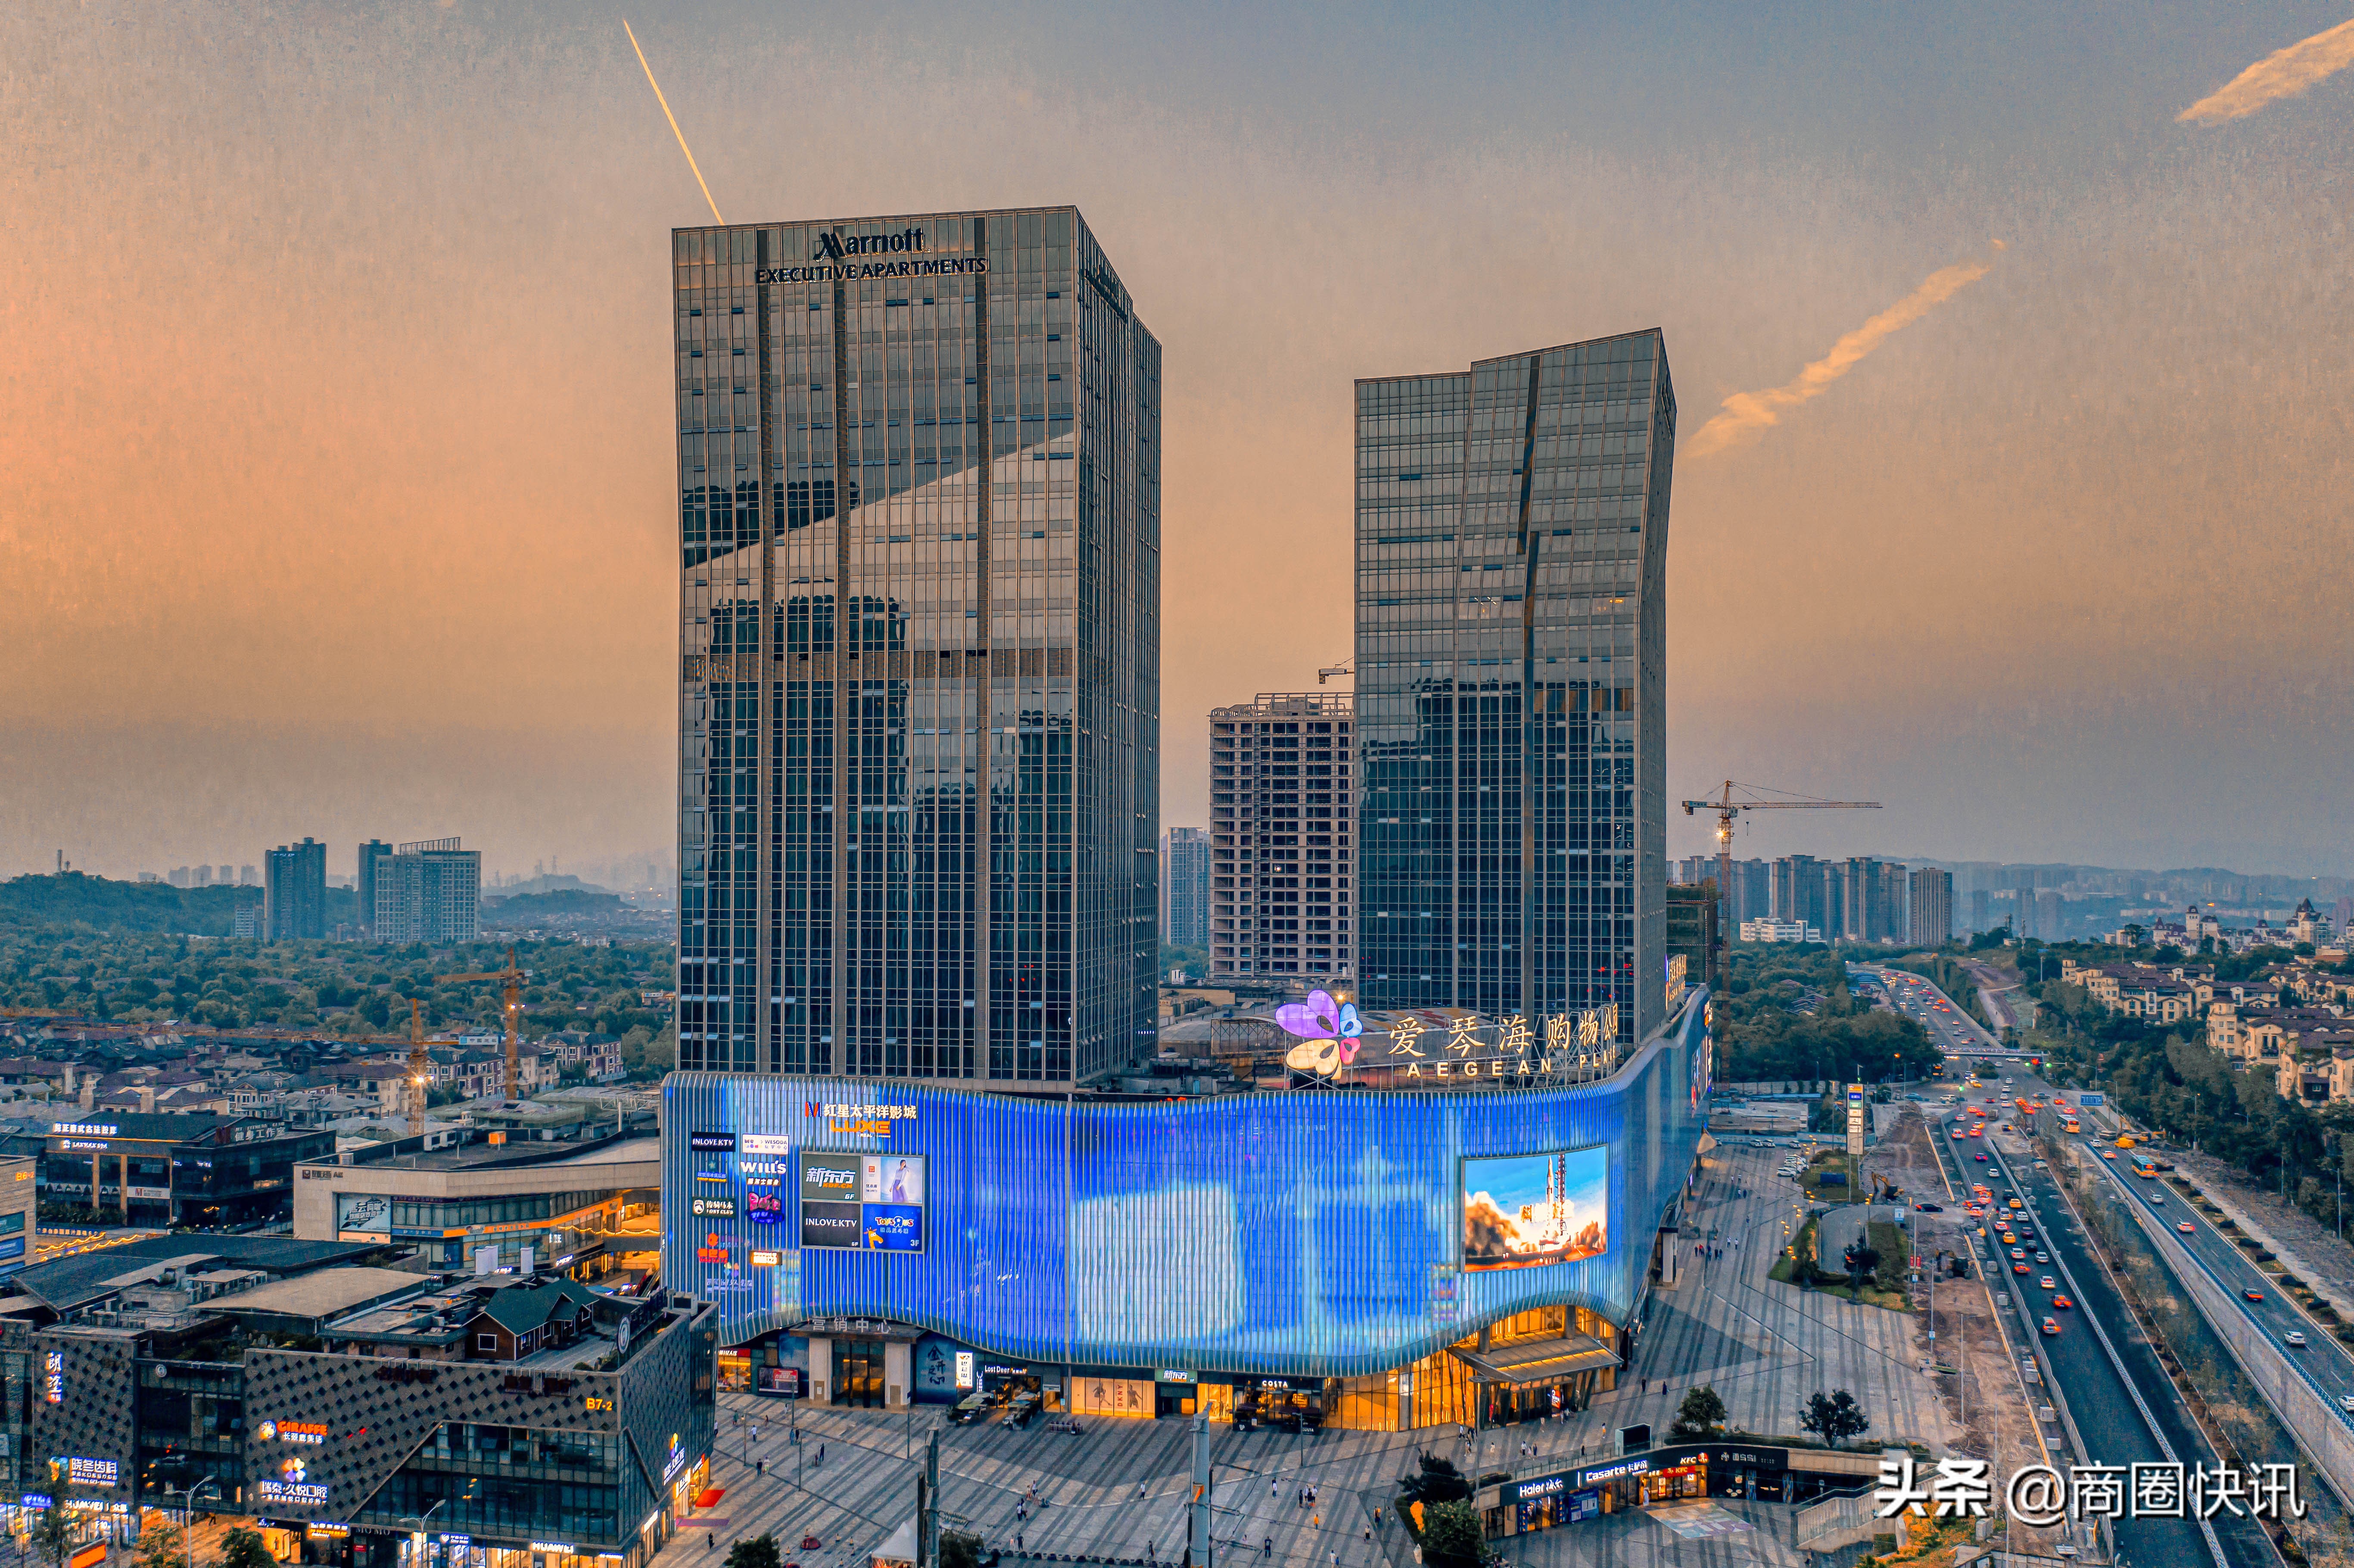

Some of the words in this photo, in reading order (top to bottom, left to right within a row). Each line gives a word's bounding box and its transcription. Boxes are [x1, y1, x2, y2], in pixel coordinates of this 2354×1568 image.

[813, 227, 927, 261] Marriott
[755, 264, 857, 284] EXECUTIVE
[860, 257, 988, 279] APARTMENTS
[1389, 1002, 1618, 1057] 爱琴海购物公园
[1407, 1058, 1551, 1077] AEGEAN
[823, 1103, 917, 1119] 红星太平洋影城
[830, 1120, 891, 1133] LUXE
[16, 1172, 34, 1181] B6-2
[806, 1167, 856, 1187] 新东方
[812, 1316, 892, 1334] 营销中心
[1262, 1380, 1288, 1388] COSTA
[586, 1397, 613, 1411] B7-2
[276, 1421, 328, 1436] GIRAFFE
[283, 1432, 323, 1444] 长颈鹿美语
[72, 1458, 117, 1475] 晓冬齿科
[1586, 1465, 1625, 1482] Casarte
[1519, 1484, 1544, 1497] Haier
